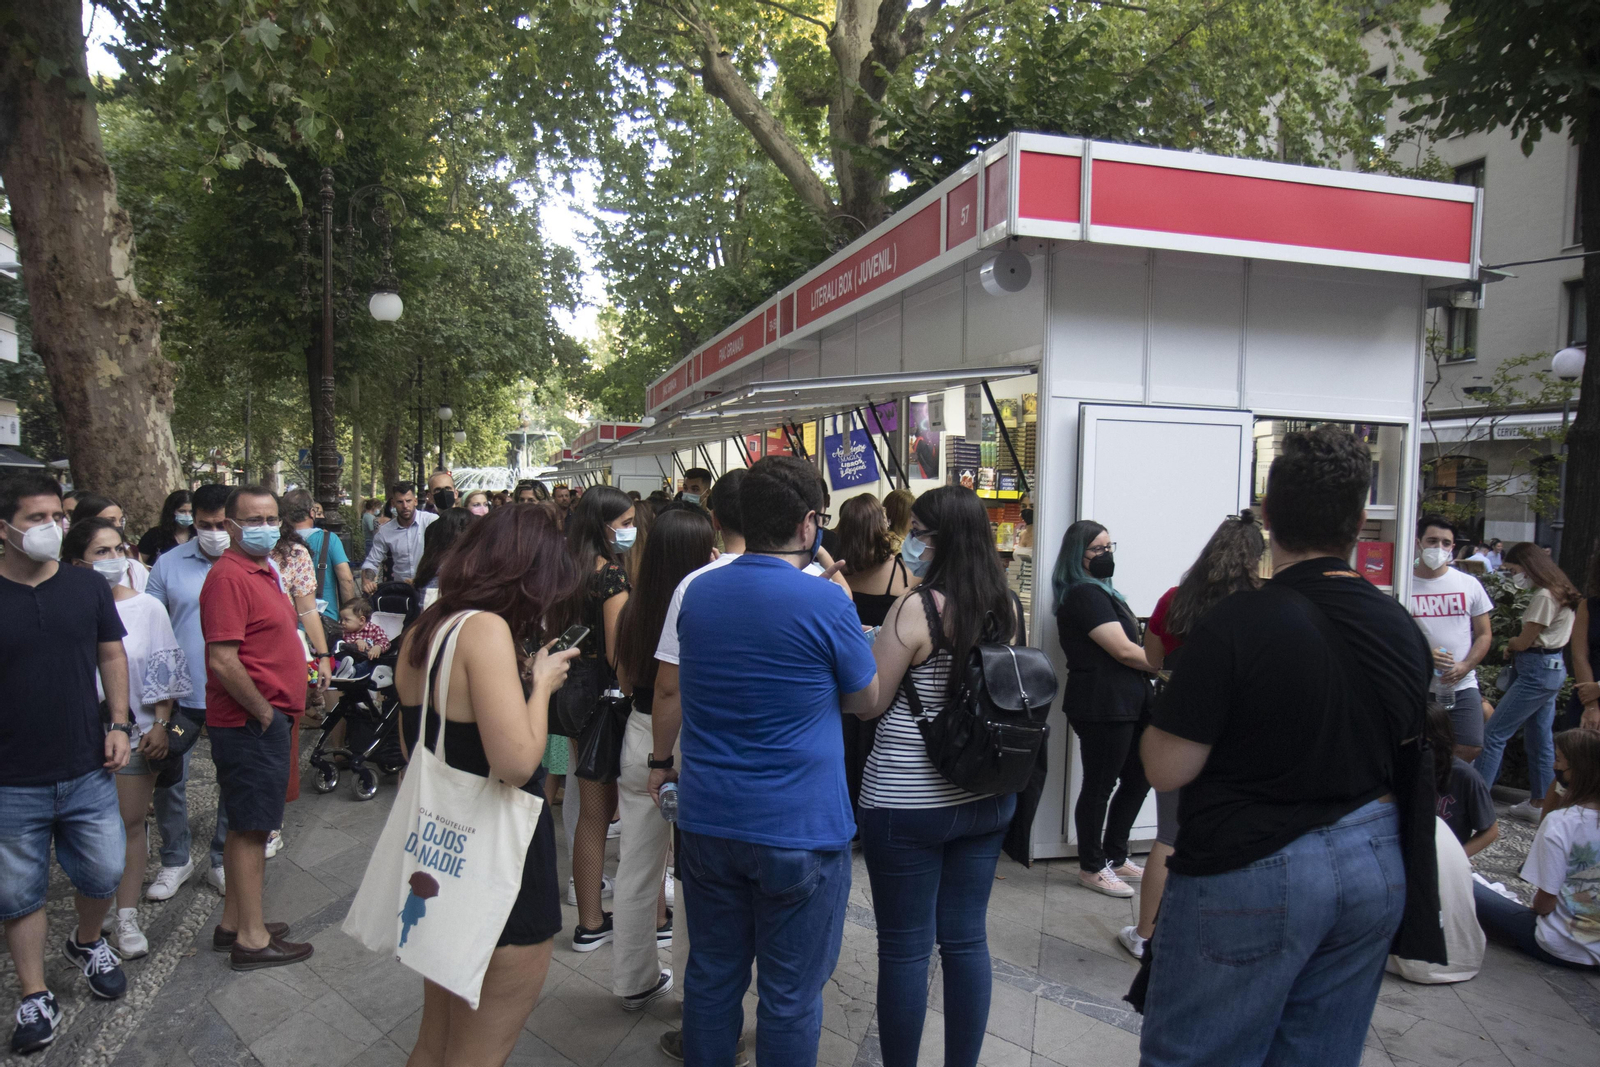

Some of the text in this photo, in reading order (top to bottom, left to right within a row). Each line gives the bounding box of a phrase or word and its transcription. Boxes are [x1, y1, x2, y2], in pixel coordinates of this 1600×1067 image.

[961, 204, 970, 226] 57
[838, 269, 853, 296] BOX
[419, 807, 433, 818] OLA
[435, 814, 477, 834] BOUTELLIER
[422, 821, 467, 854] OJOS
[417, 844, 467, 878] NADIE
